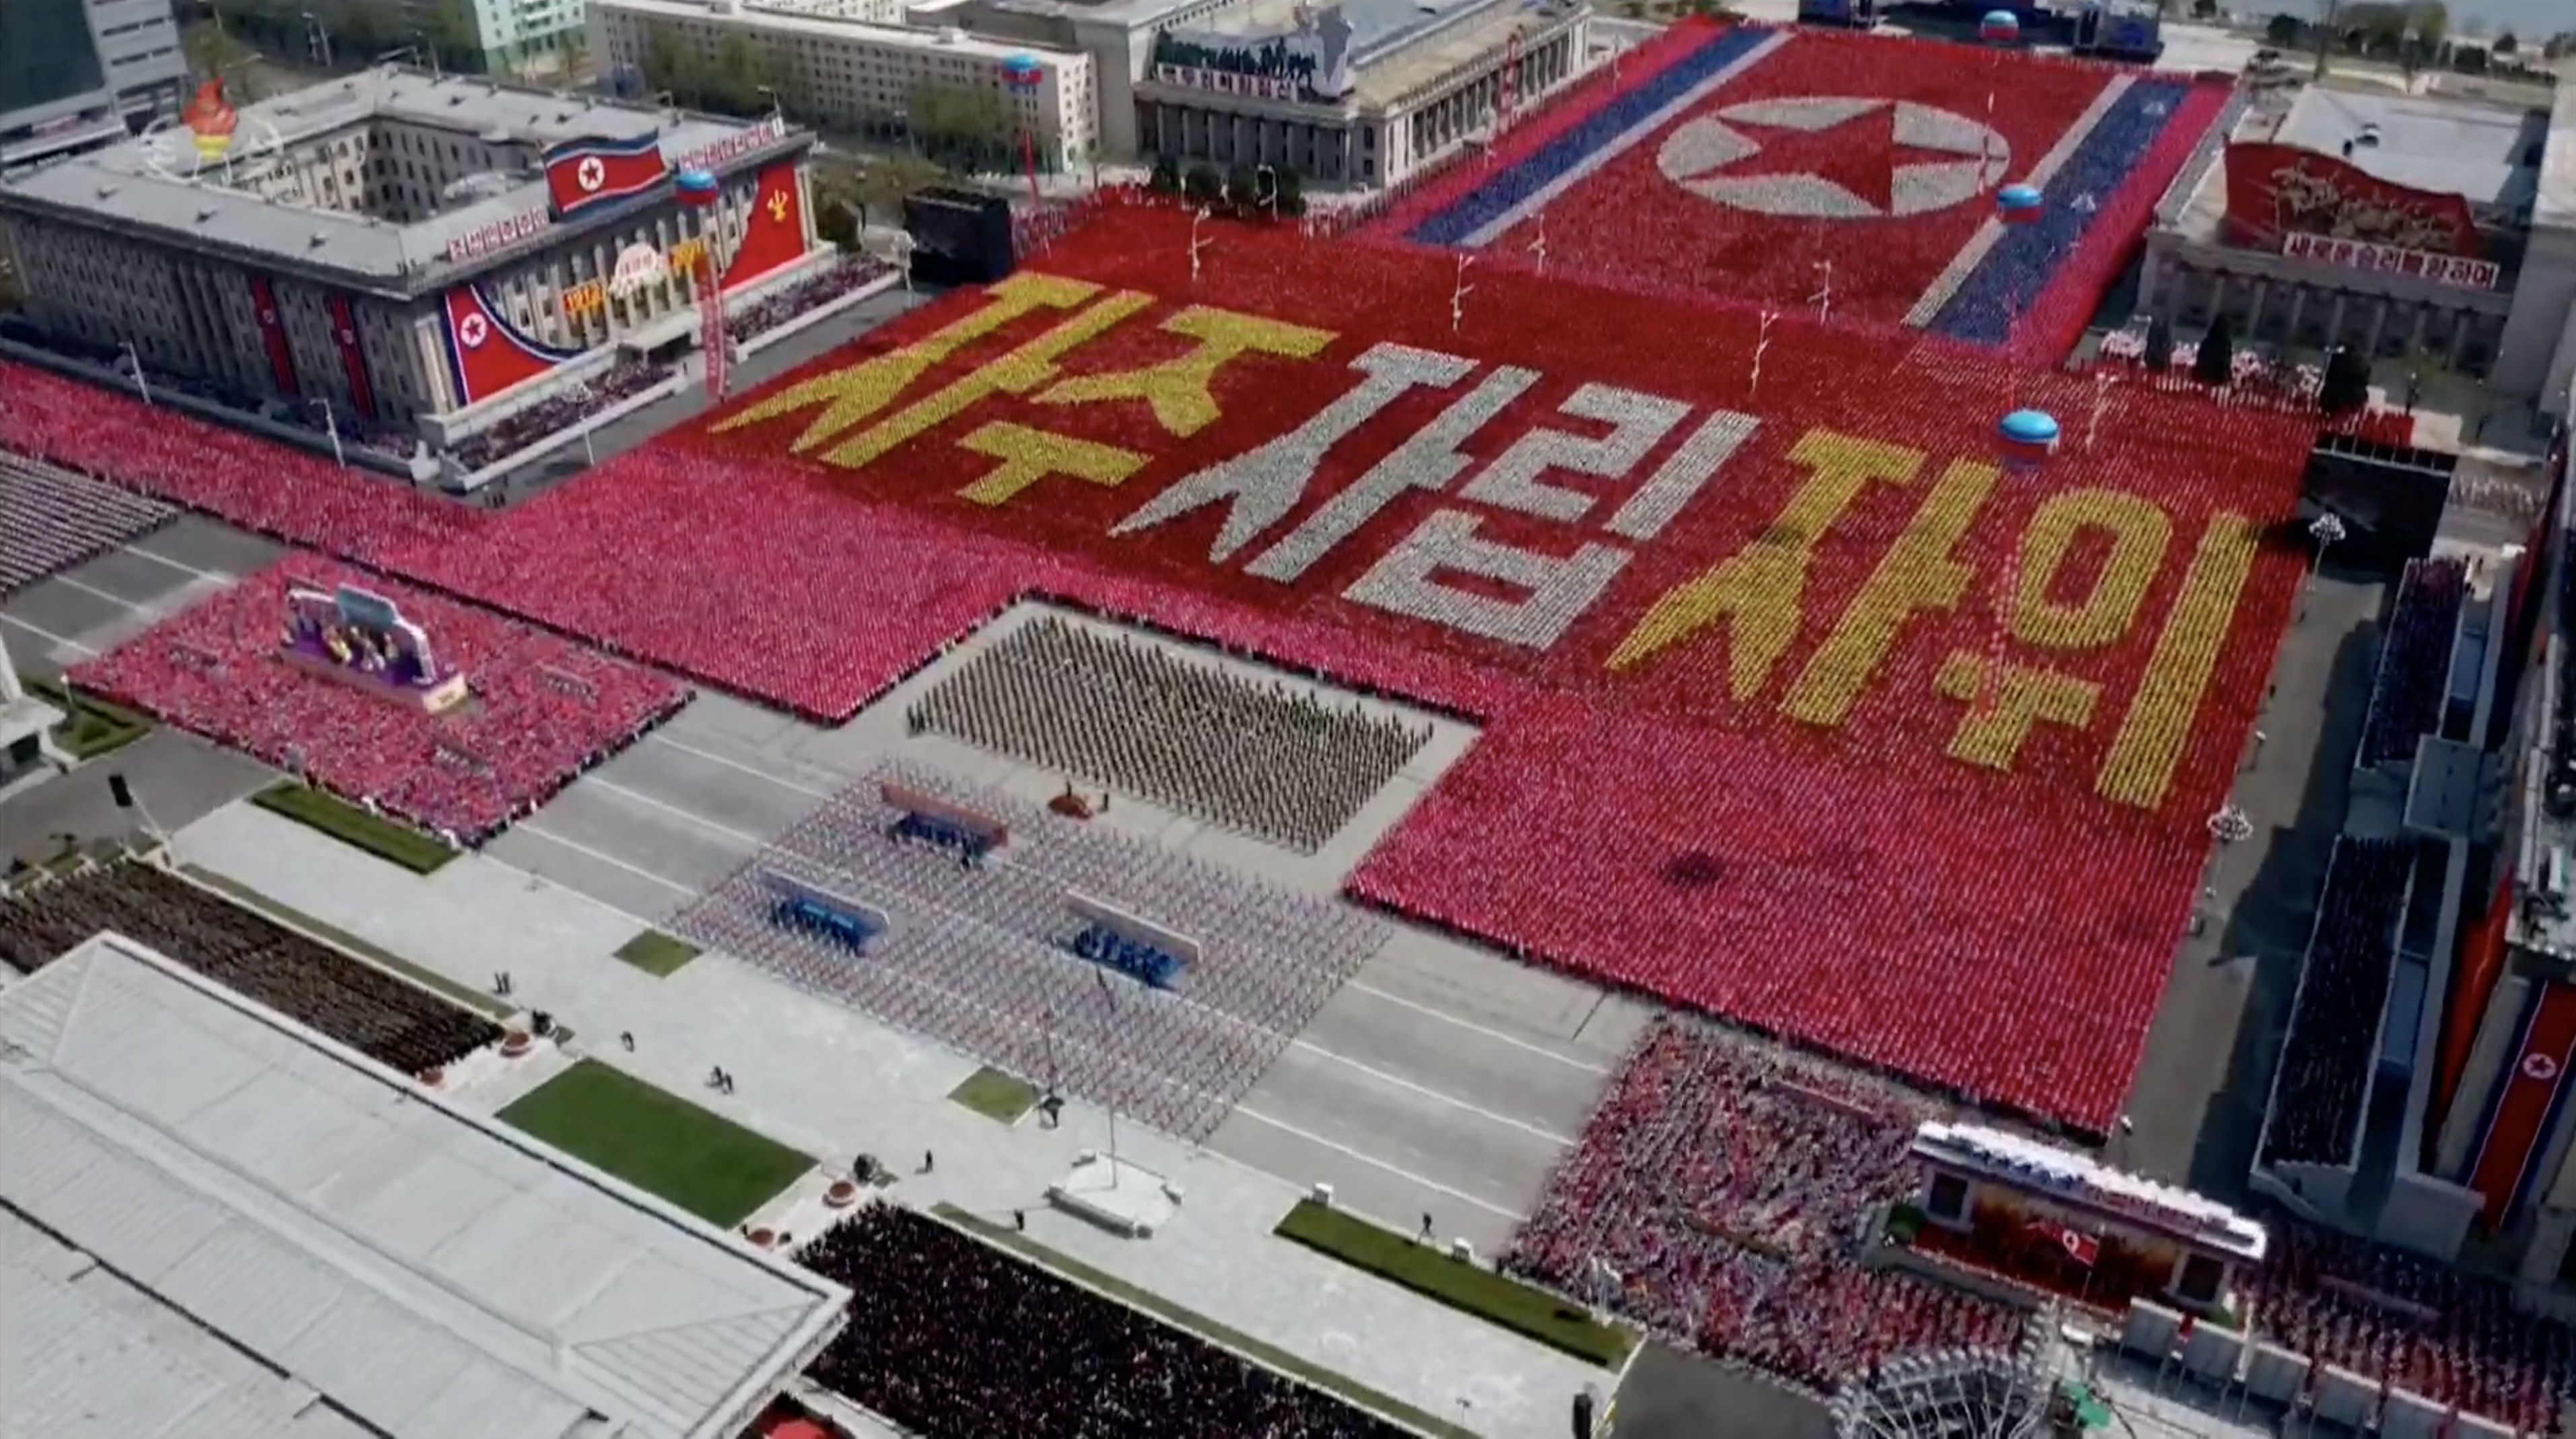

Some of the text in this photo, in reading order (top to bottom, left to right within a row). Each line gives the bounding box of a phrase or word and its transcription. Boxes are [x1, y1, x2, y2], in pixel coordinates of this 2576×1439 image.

[707, 271, 1341, 507] 자주
[1105, 341, 1762, 651] 자립
[1602, 426, 2260, 809] 자위
